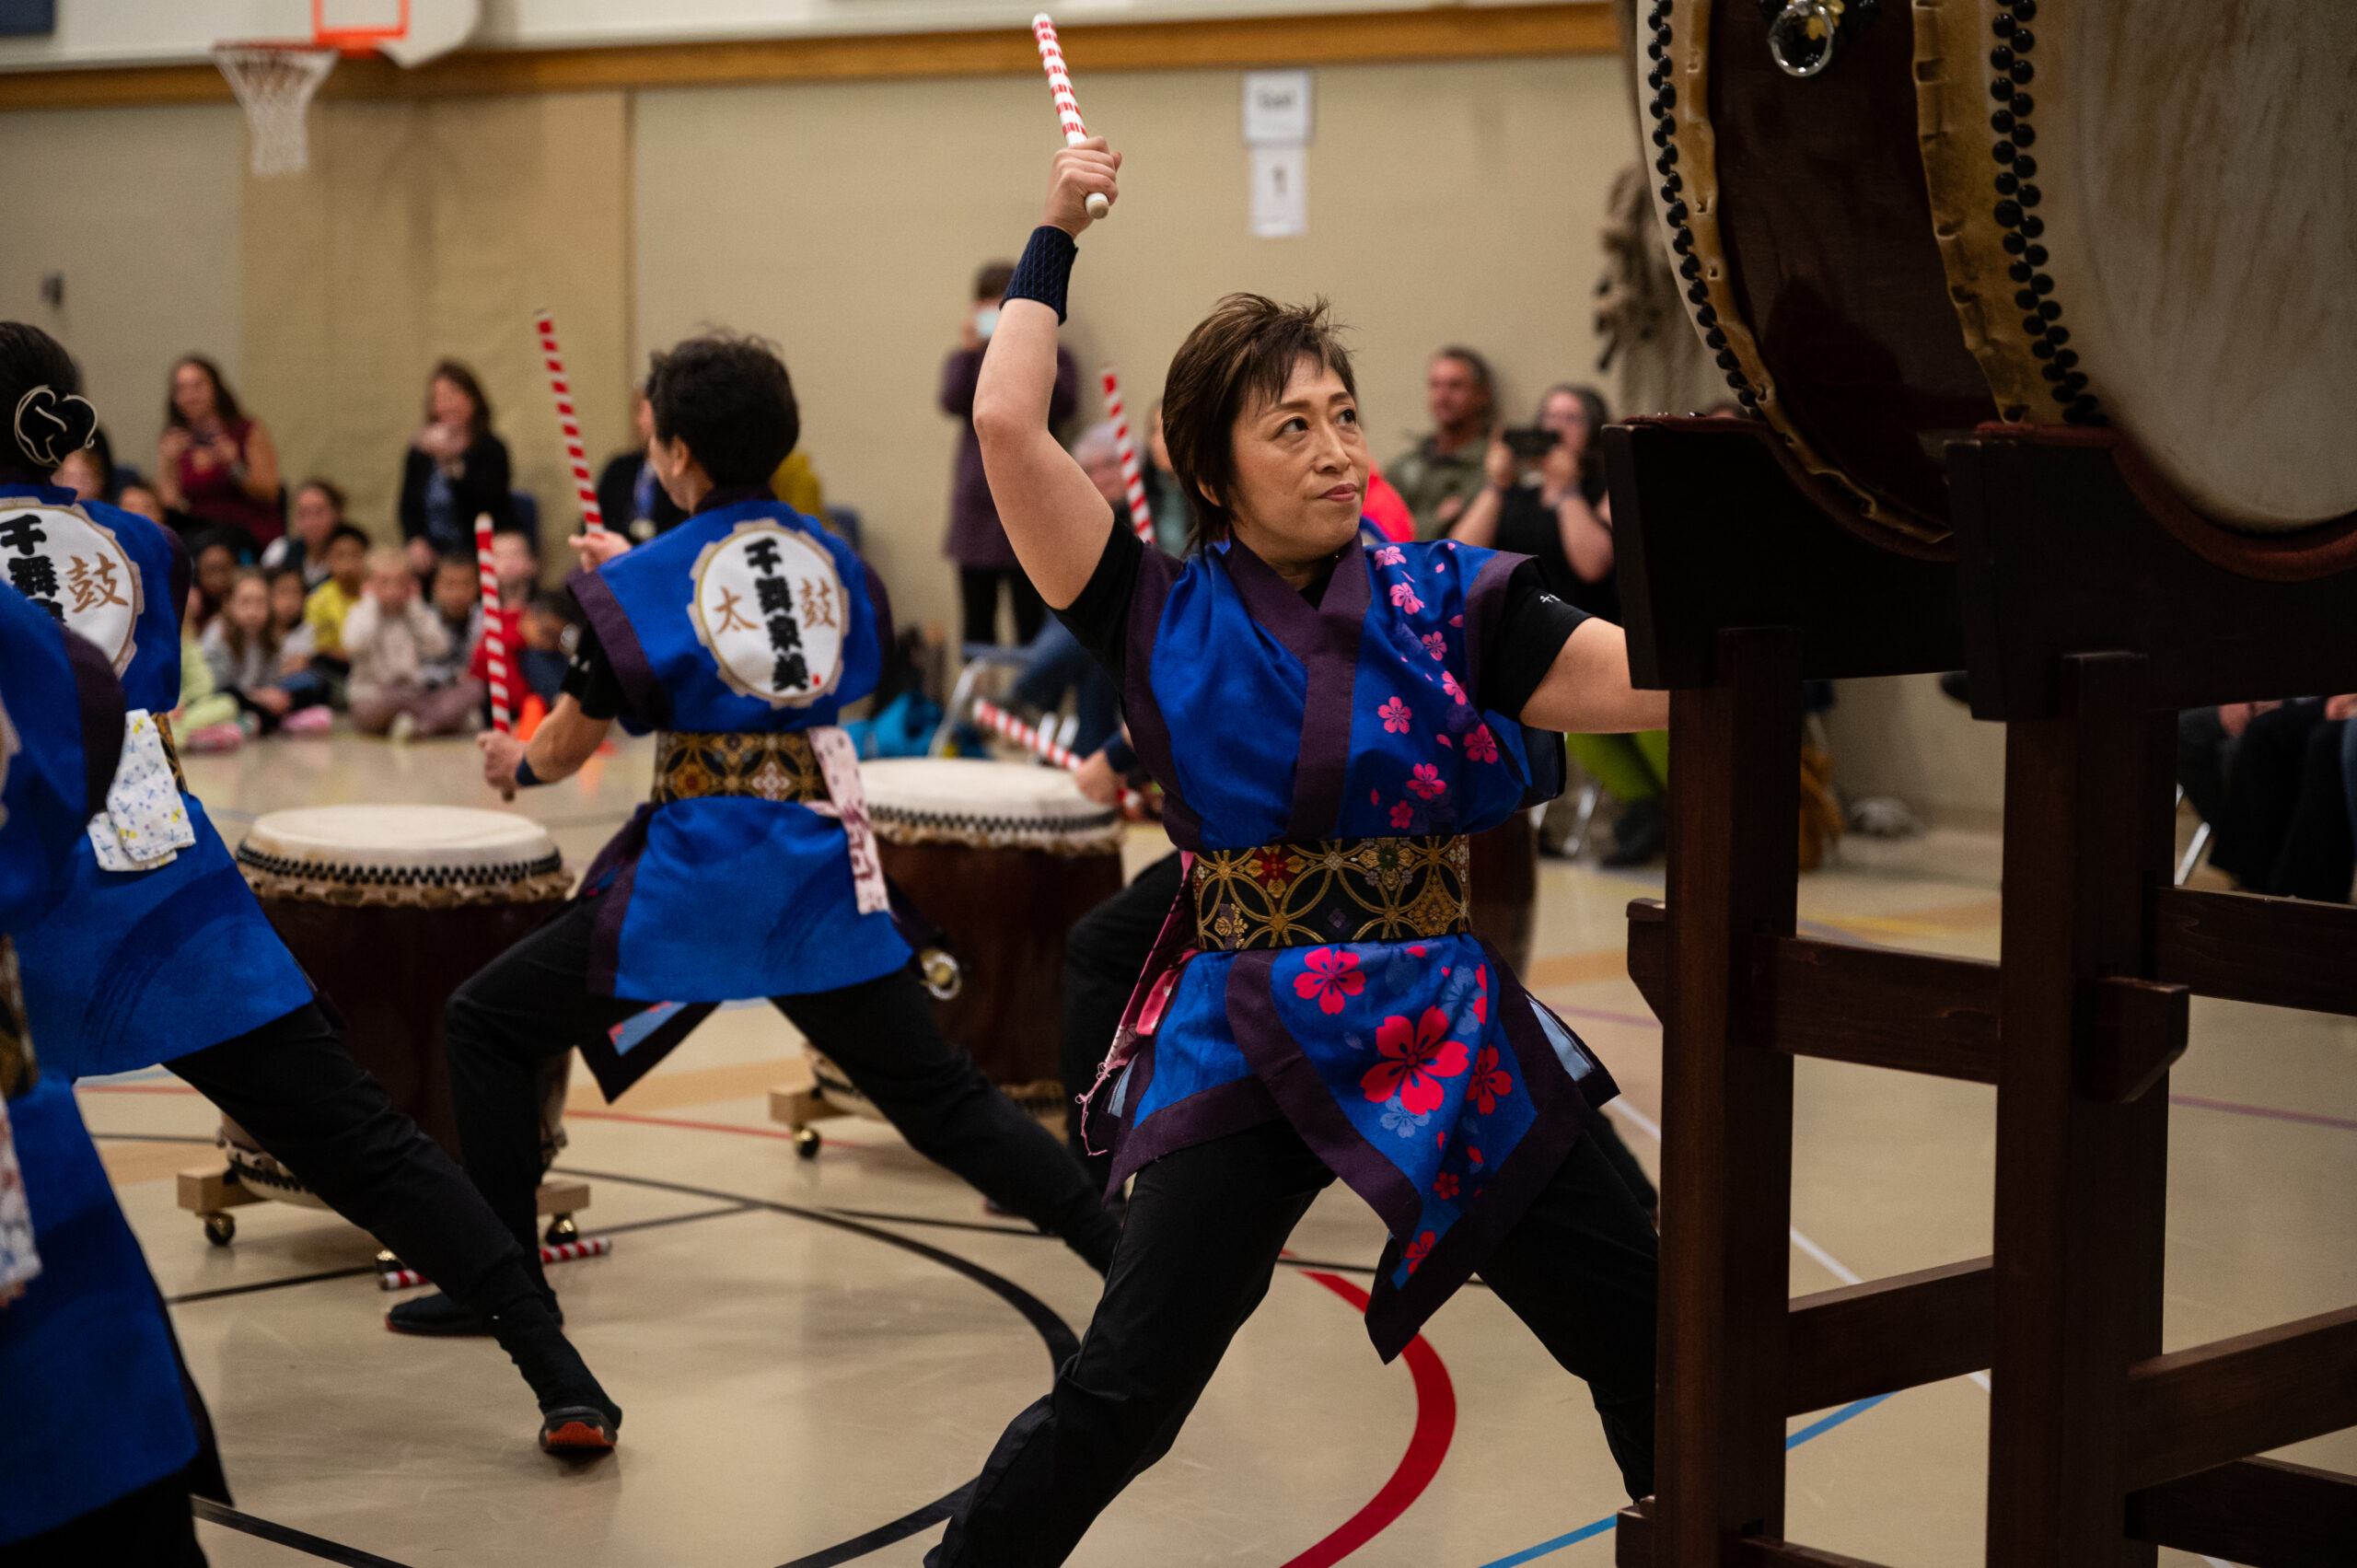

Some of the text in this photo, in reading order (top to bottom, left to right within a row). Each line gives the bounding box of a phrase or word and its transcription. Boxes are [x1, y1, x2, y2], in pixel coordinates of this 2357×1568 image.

[66, 552, 129, 613] 鼓
[714, 577, 836, 634] 太 鼓
